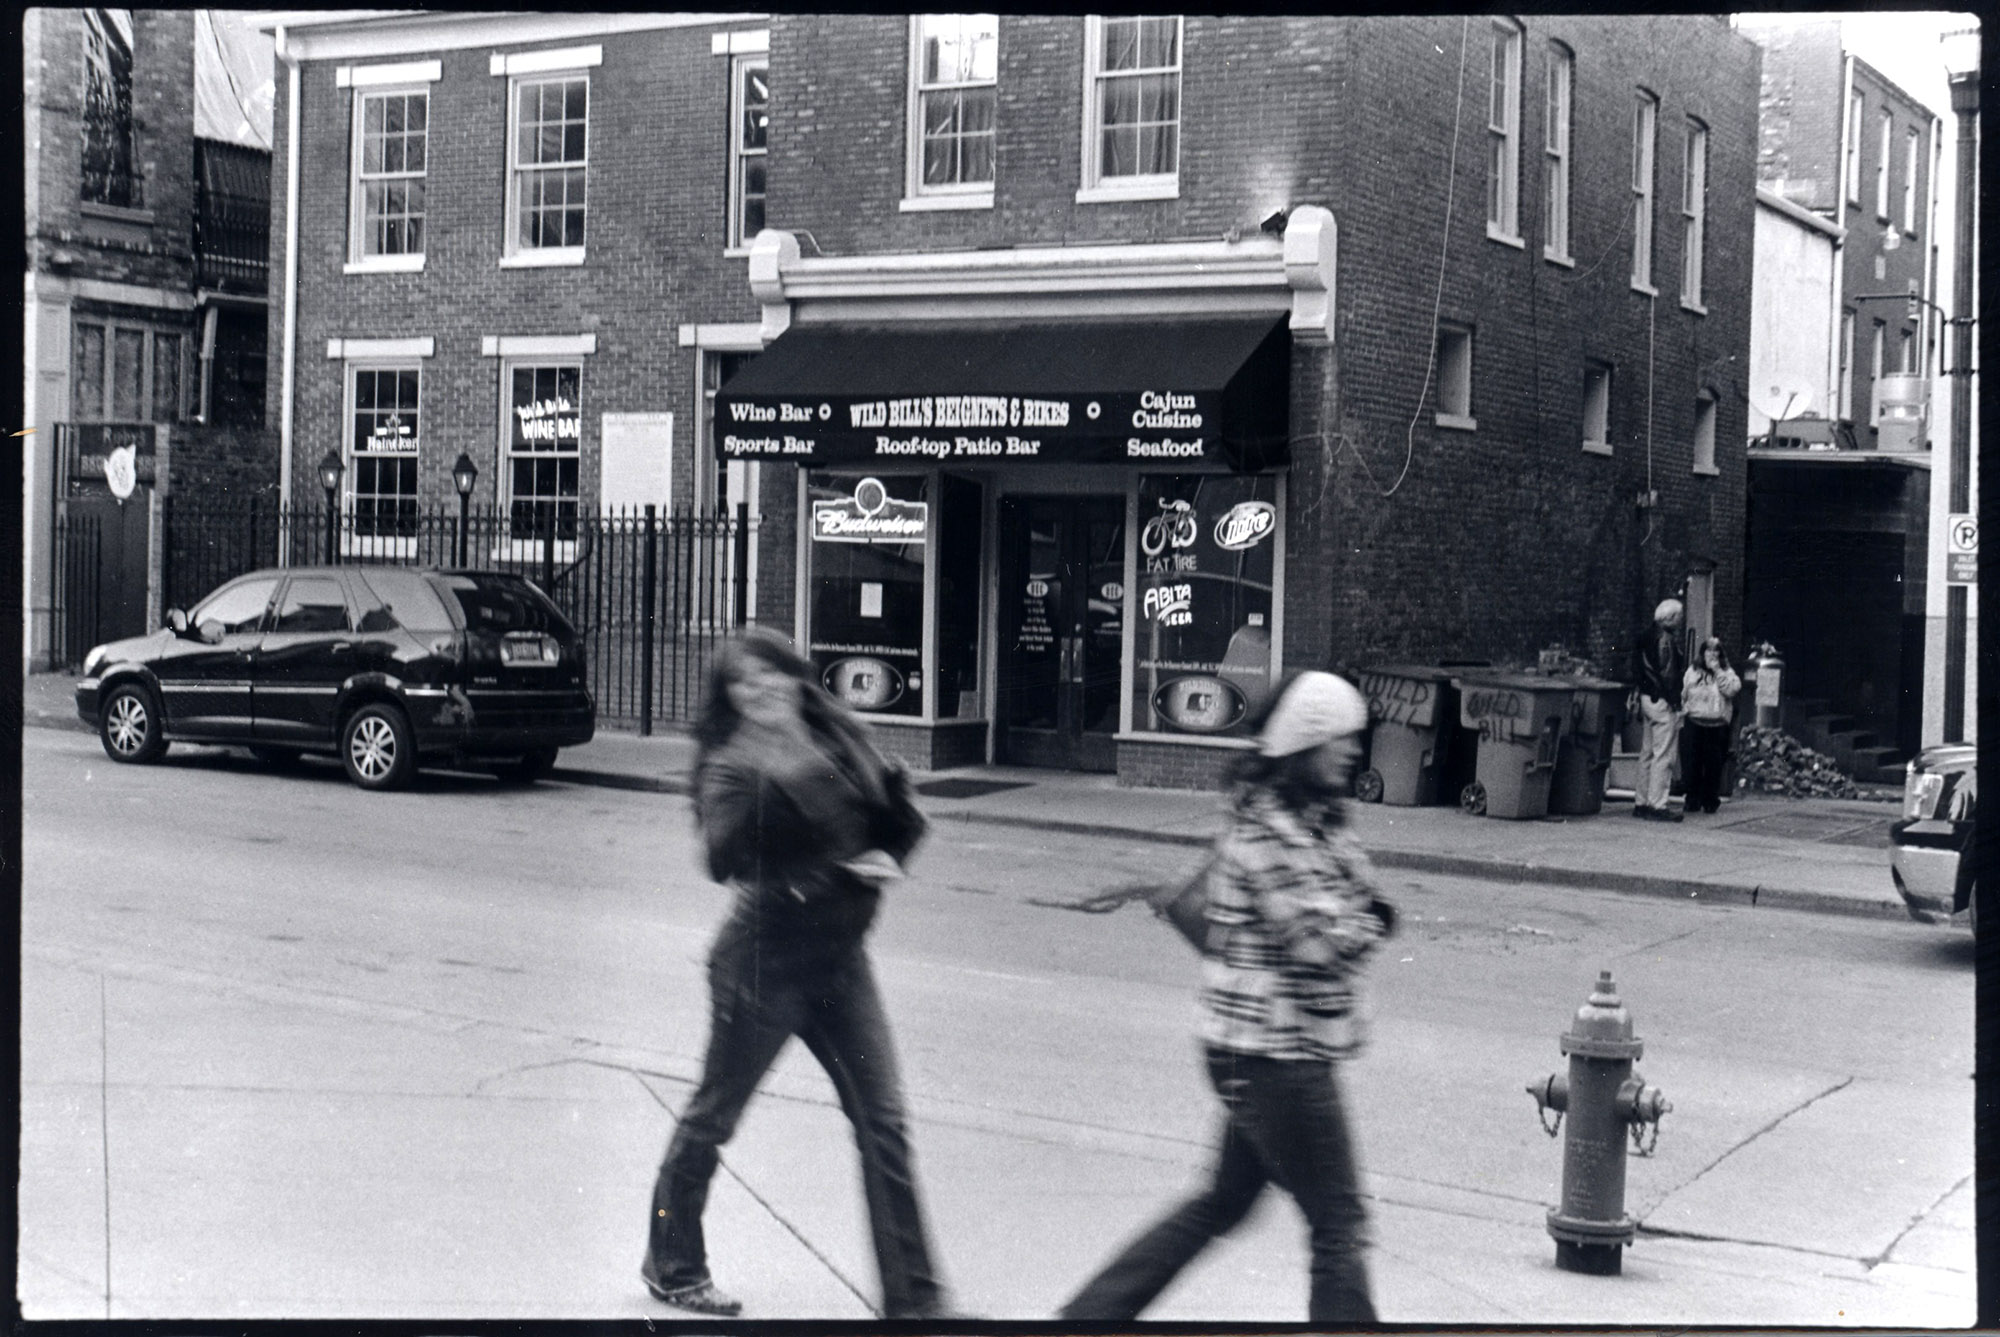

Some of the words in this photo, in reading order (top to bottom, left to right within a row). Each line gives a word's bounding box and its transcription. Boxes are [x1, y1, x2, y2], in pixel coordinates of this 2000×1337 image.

[729, 403, 777, 421] Wine
[780, 403, 814, 421] Bar
[850, 402, 887, 428] WILD
[888, 397, 933, 428] BILL'S
[935, 395, 1008, 428] BEIGNETS
[1010, 397, 1021, 427] &
[1023, 399, 1070, 427] BIKES
[1140, 390, 1196, 413] Cajun
[520, 419, 556, 440] WINE
[1132, 410, 1203, 428] Cuisine
[724, 435, 780, 456] Sports
[782, 435, 816, 454] Bar
[875, 436, 951, 459] Roof-top
[954, 436, 1003, 456] Patio
[1006, 436, 1041, 456] Bar
[1127, 437, 1204, 457] Seafood
[817, 510, 925, 535] Budweiser
[1146, 556, 1170, 573] FAT
[1171, 553, 1197, 571] TIRE
[1143, 584, 1192, 619] ABITA
[1364, 676, 1429, 705] WILD
[1478, 718, 1519, 744] BILL
